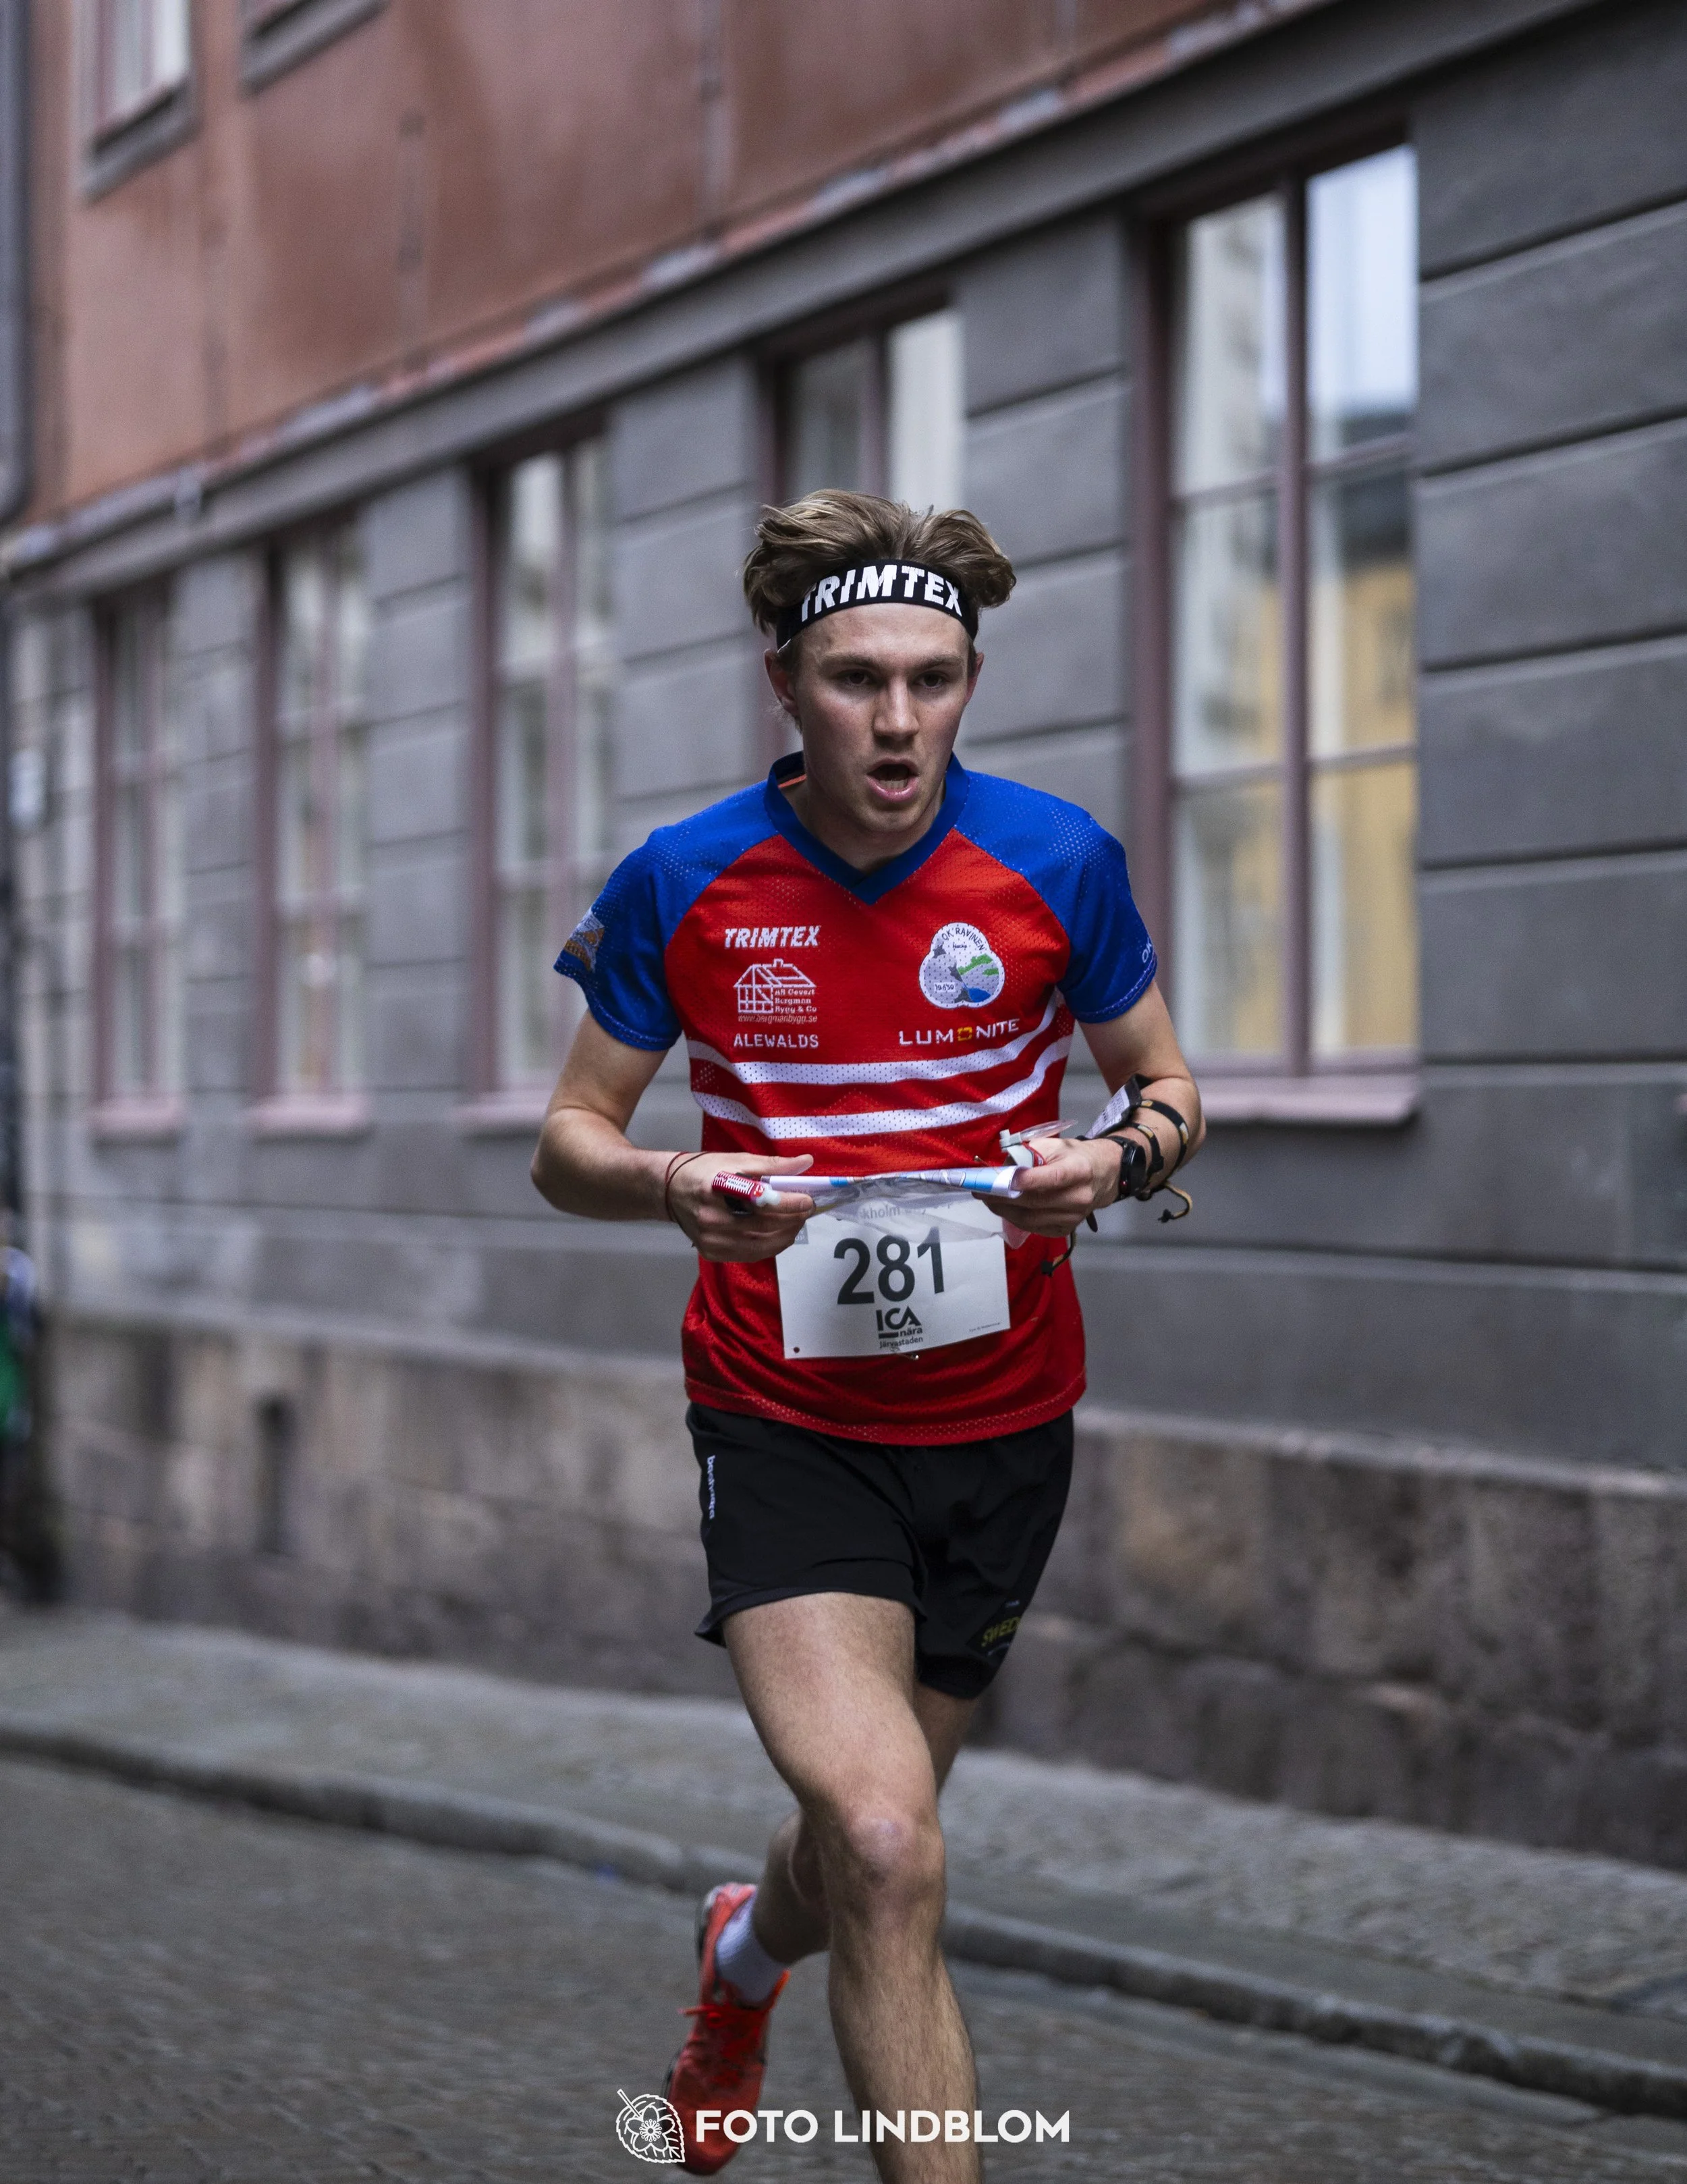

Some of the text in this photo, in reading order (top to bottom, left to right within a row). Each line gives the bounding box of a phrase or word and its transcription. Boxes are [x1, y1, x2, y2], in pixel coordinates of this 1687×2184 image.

[725, 925, 821, 948] TRIMTEX
[942, 927, 985, 950] OK RAVINEN
[734, 1033, 819, 1048] ALEWALDS
[899, 1018, 1020, 1045] LUMONITE
[833, 1226, 945, 1305] 281
[876, 1306, 922, 1331] ICA
[900, 1326, 922, 1336] nära
